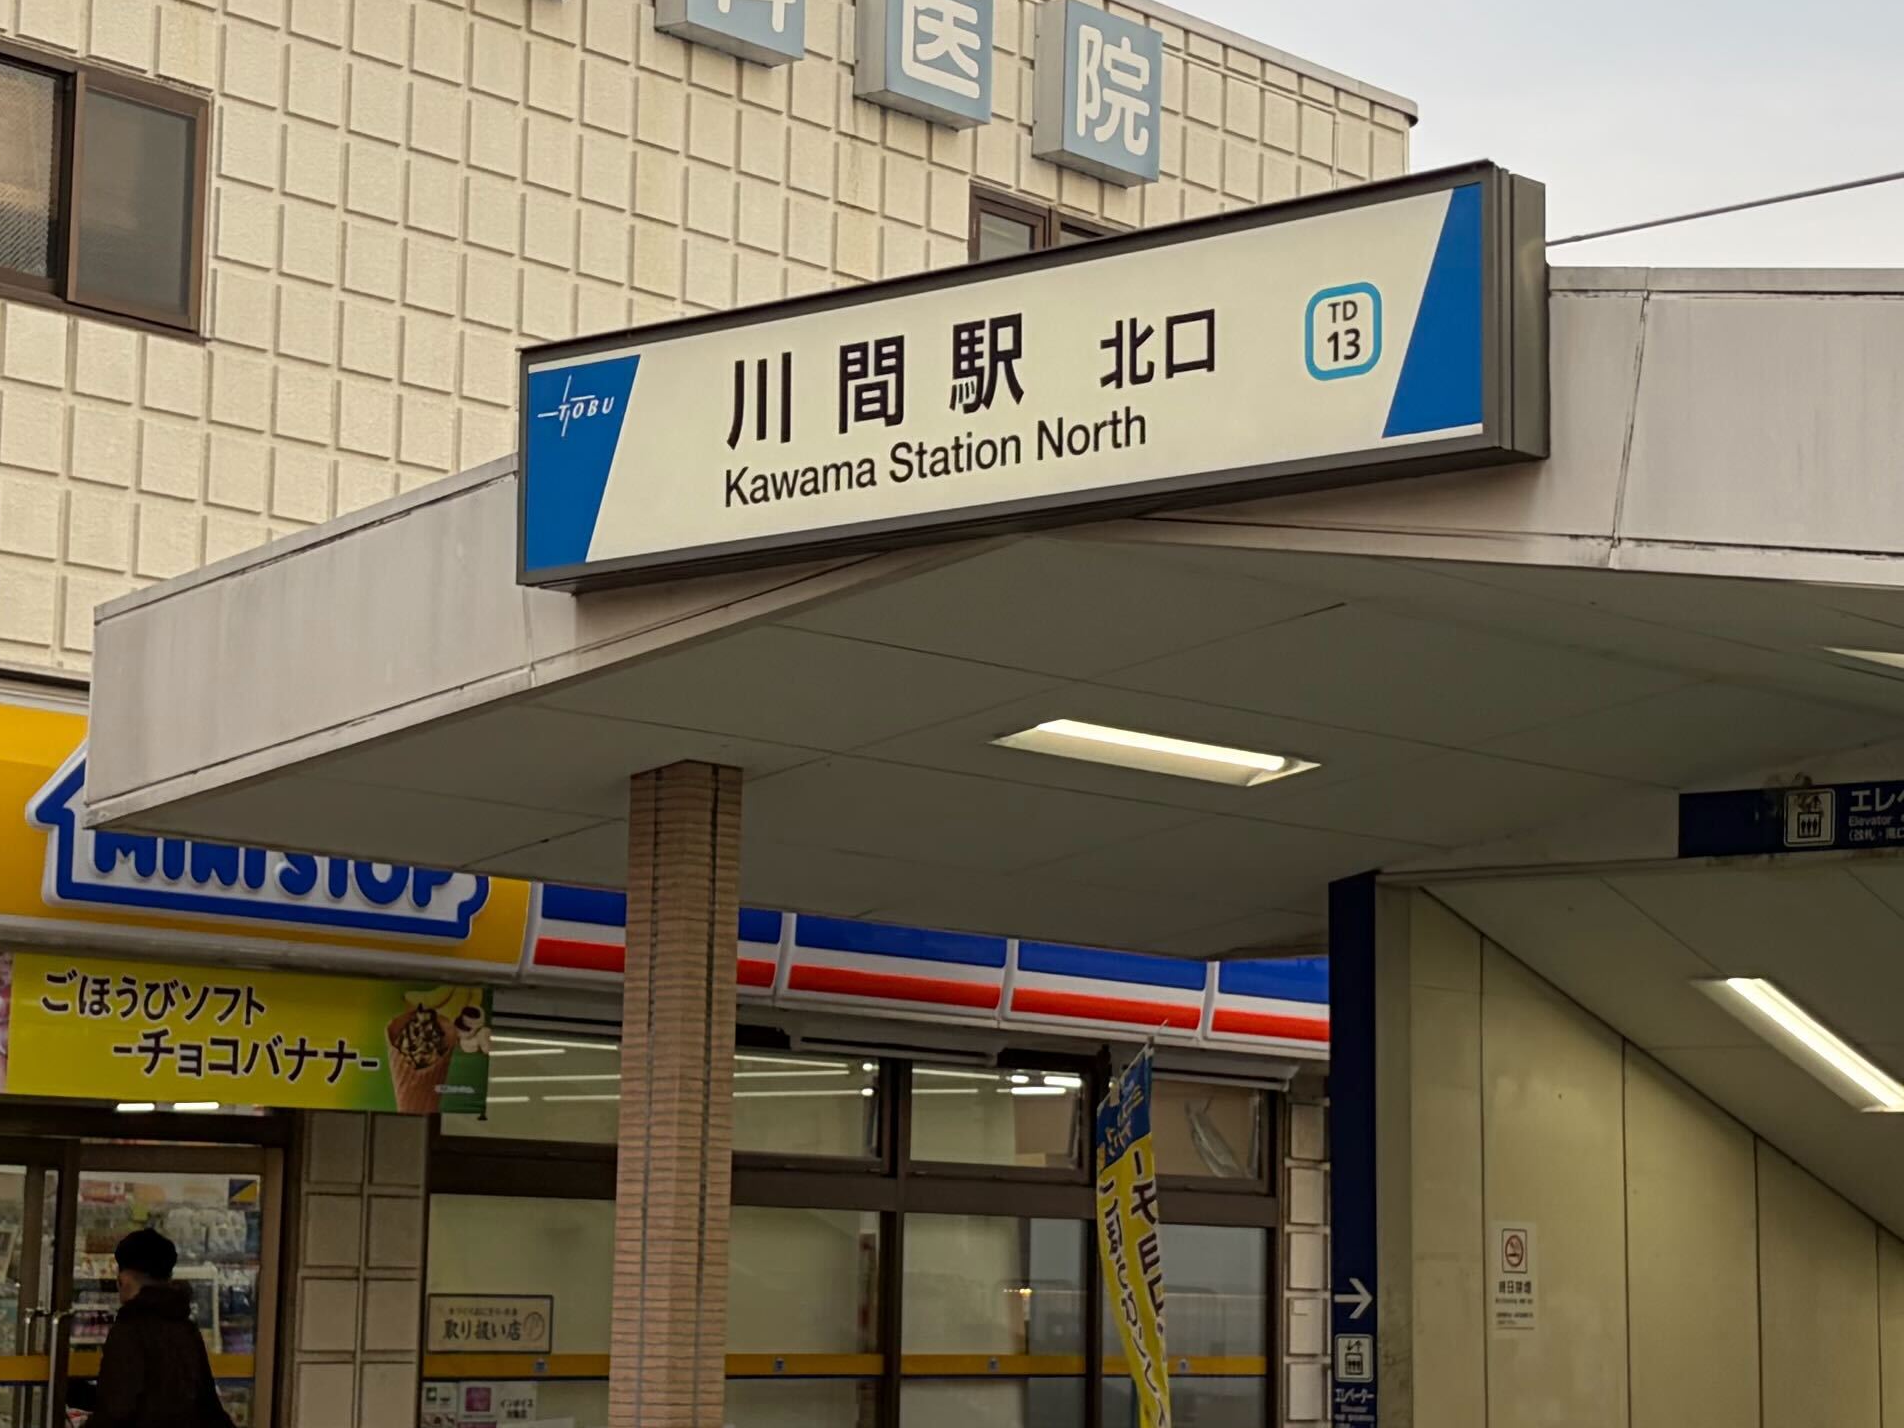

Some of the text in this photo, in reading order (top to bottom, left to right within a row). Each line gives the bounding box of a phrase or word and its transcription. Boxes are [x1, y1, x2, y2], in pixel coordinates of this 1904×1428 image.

[1326, 299, 1359, 324] TD
[1324, 329, 1361, 364] 13
[725, 308, 1217, 451] 川間駅 北口
[723, 409, 1148, 509] Kawama Station North
[42, 969, 265, 1025] ごほうびソフト
[443, 1319, 522, 1341] 取り扱い店
